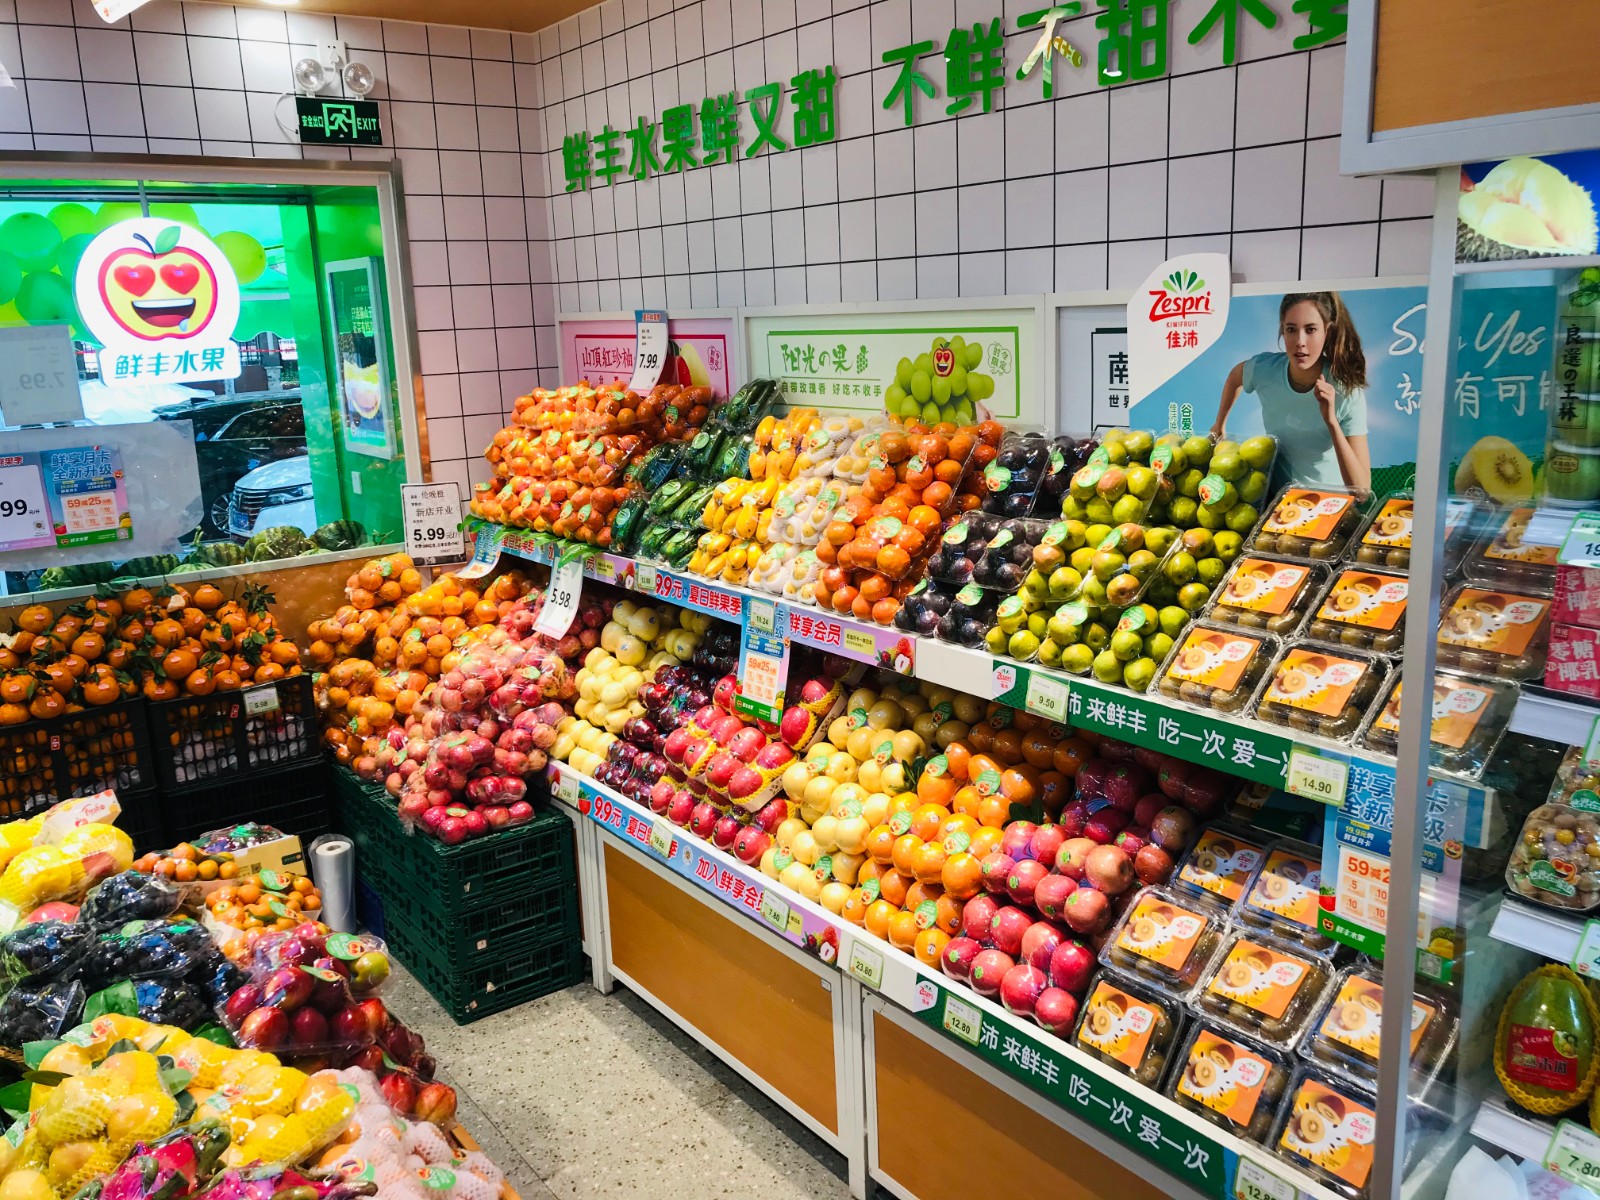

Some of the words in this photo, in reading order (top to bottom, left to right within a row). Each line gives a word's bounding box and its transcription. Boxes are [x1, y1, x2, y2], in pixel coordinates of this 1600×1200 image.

[301, 115, 324, 128] 安全出口
[356, 117, 377, 130] EXIT
[1148, 291, 1212, 323] Zespri
[1166, 320, 1198, 328] KIWIFRUIT
[1166, 330, 1198, 349] 佳沛
[1474, 309, 1547, 369] Yes
[114, 347, 225, 379] 鲜丰水果
[639, 353, 658, 369] 7.99
[832, 383, 882, 397] 好吃不收手
[51, 450, 111, 467] 鲜享月卡
[52, 464, 112, 482] 全新升级
[416, 506, 454, 517] 新店开业
[413, 527, 445, 541] 5.99
[550, 587, 572, 608] 5.98
[689, 584, 742, 616] 夏日鲜果季
[1039, 695, 1055, 709] 9.50
[1086, 697, 1148, 734] 来鲜丰
[1158, 717, 1226, 760] 吃一次
[1230, 737, 1290, 777] 爱一
[1302, 777, 1332, 794] 14.90
[1351, 880, 1358, 889] 5
[1376, 889, 1388, 900] 10
[1348, 900, 1358, 910] 10
[1375, 907, 1386, 918] 10
[1335, 924, 1366, 943] 鲜丰水果
[855, 960, 873, 977] 23.80
[951, 1017, 971, 1034] 12.80
[1001, 1035, 1060, 1085] 来鲜丰
[1068, 1073, 1133, 1133] 吃一次
[1136, 1113, 1211, 1178] 爱一次
[1568, 1154, 1600, 1178] 7.80
